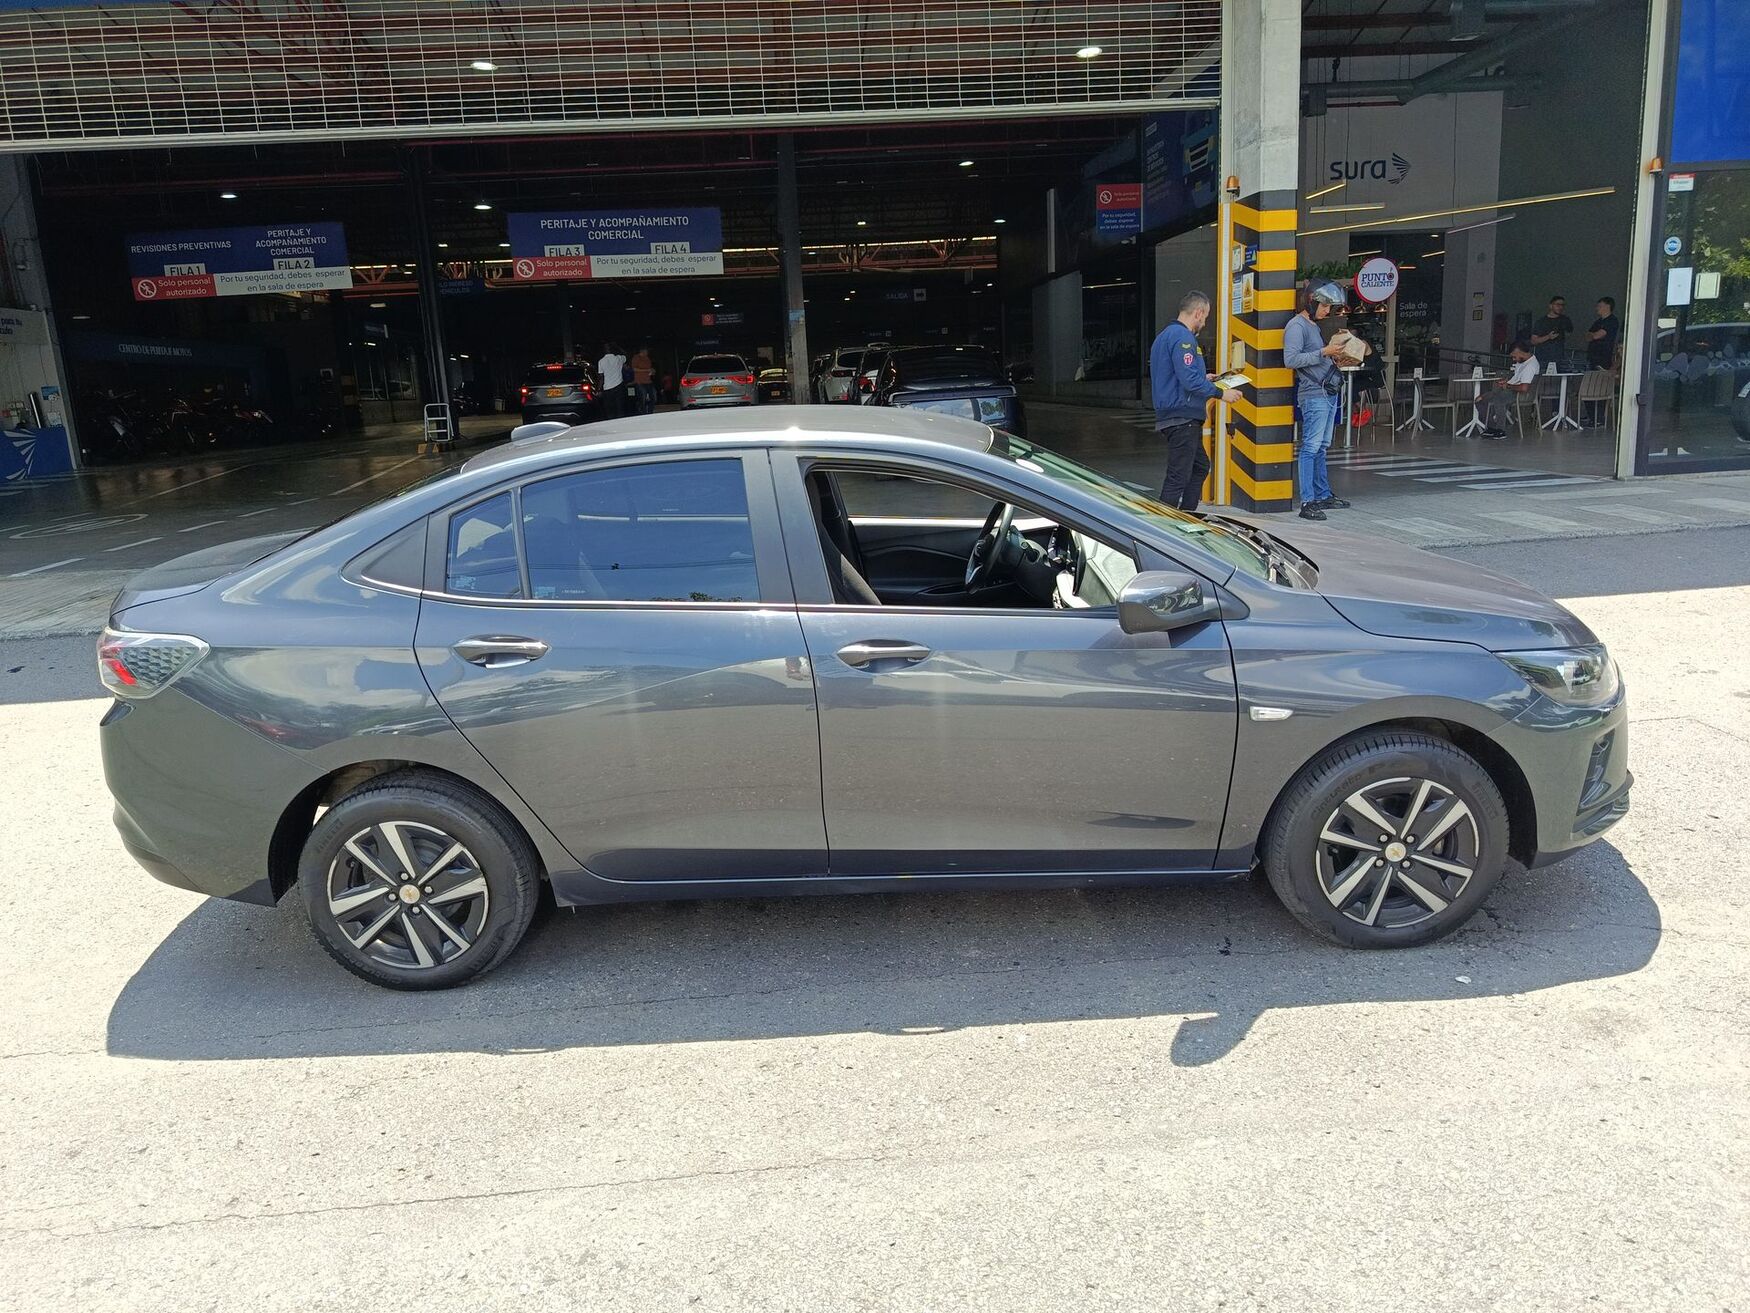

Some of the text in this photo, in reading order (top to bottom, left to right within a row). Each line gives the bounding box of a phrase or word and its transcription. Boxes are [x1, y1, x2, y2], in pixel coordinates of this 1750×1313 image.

[1330, 159, 1387, 180] sura
[540, 215, 689, 229] PERITAJE Y ACOMPAÑAMIENTO
[267, 228, 312, 238] PERITAJE Y
[588, 230, 645, 240] COMERCIAL
[131, 240, 232, 254] REVISIONES PREVENTIVAS
[255, 236, 327, 248] ACOMPAÑAMIENTO
[270, 246, 315, 256] COMERCIAL
[549, 246, 582, 257] FILA 3
[654, 244, 687, 255] FILA 4
[277, 259, 312, 271] FILA 2
[536, 258, 588, 268] Solo personal
[596, 255, 717, 266] Por tu seguridad, debes esperar
[170, 265, 202, 276] FILA 1
[543, 268, 583, 277] autorizado
[632, 266, 641, 275] la
[641, 266, 657, 275] sala
[658, 265, 669, 274] de
[669, 265, 696, 275] espera
[220, 269, 346, 284] Por tu seguridad, debes esperar
[1361, 271, 1394, 282] PUNTO
[158, 277, 211, 289] Solo personal
[247, 281, 324, 293] en la sala de espera
[165, 287, 208, 297] autorizado
[1400, 301, 1428, 310] Sala de
[1400, 310, 1427, 319] espera
